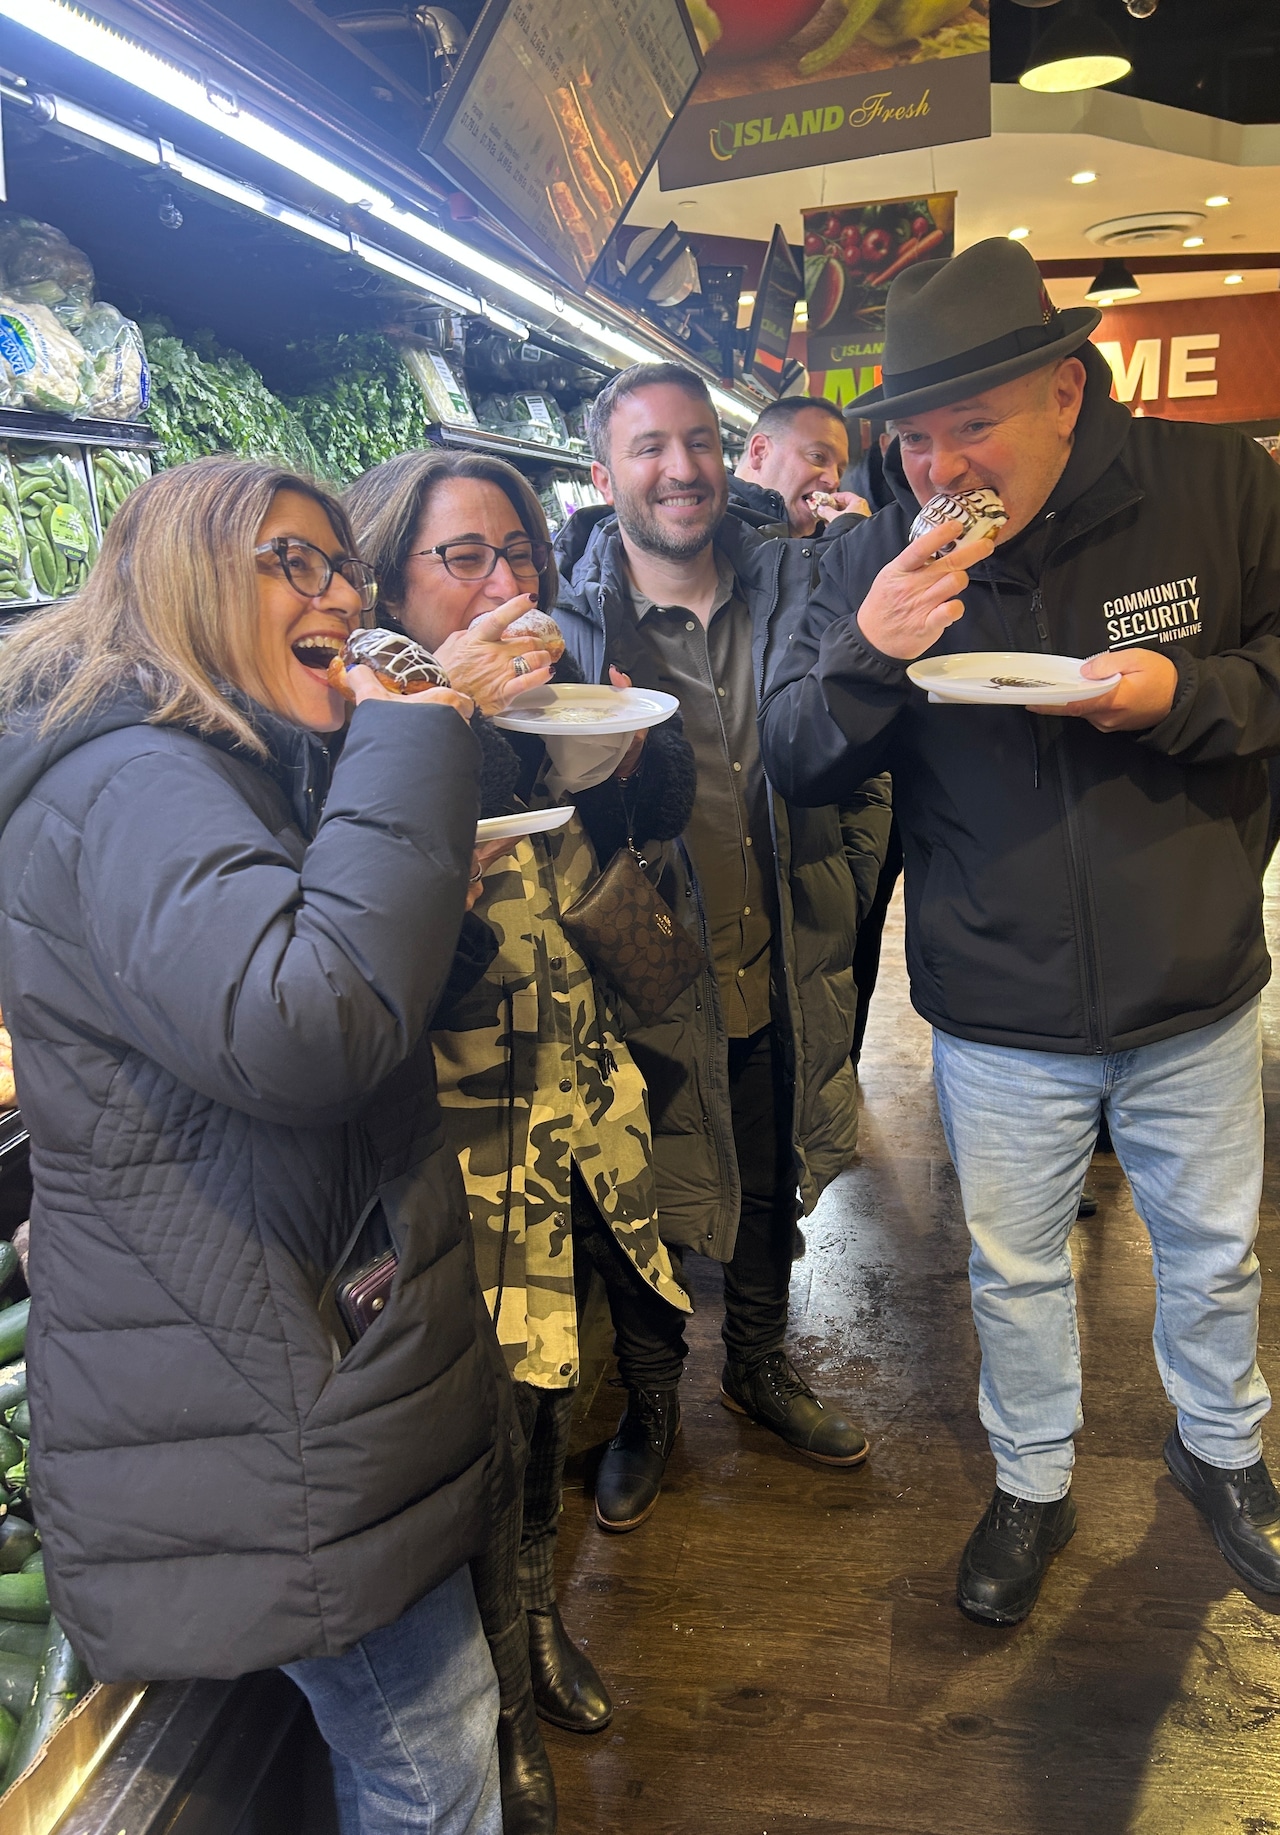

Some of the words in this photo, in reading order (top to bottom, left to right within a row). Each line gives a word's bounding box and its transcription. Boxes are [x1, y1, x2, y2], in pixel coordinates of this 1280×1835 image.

[732, 105, 845, 148] ISLAND
[849, 89, 931, 128] Fresh
[842, 342, 886, 357] ISLAN
[1103, 576, 1197, 618] COMMUNITY
[1107, 597, 1200, 641] SECURITY
[1159, 622, 1202, 643] INITIATIVE
